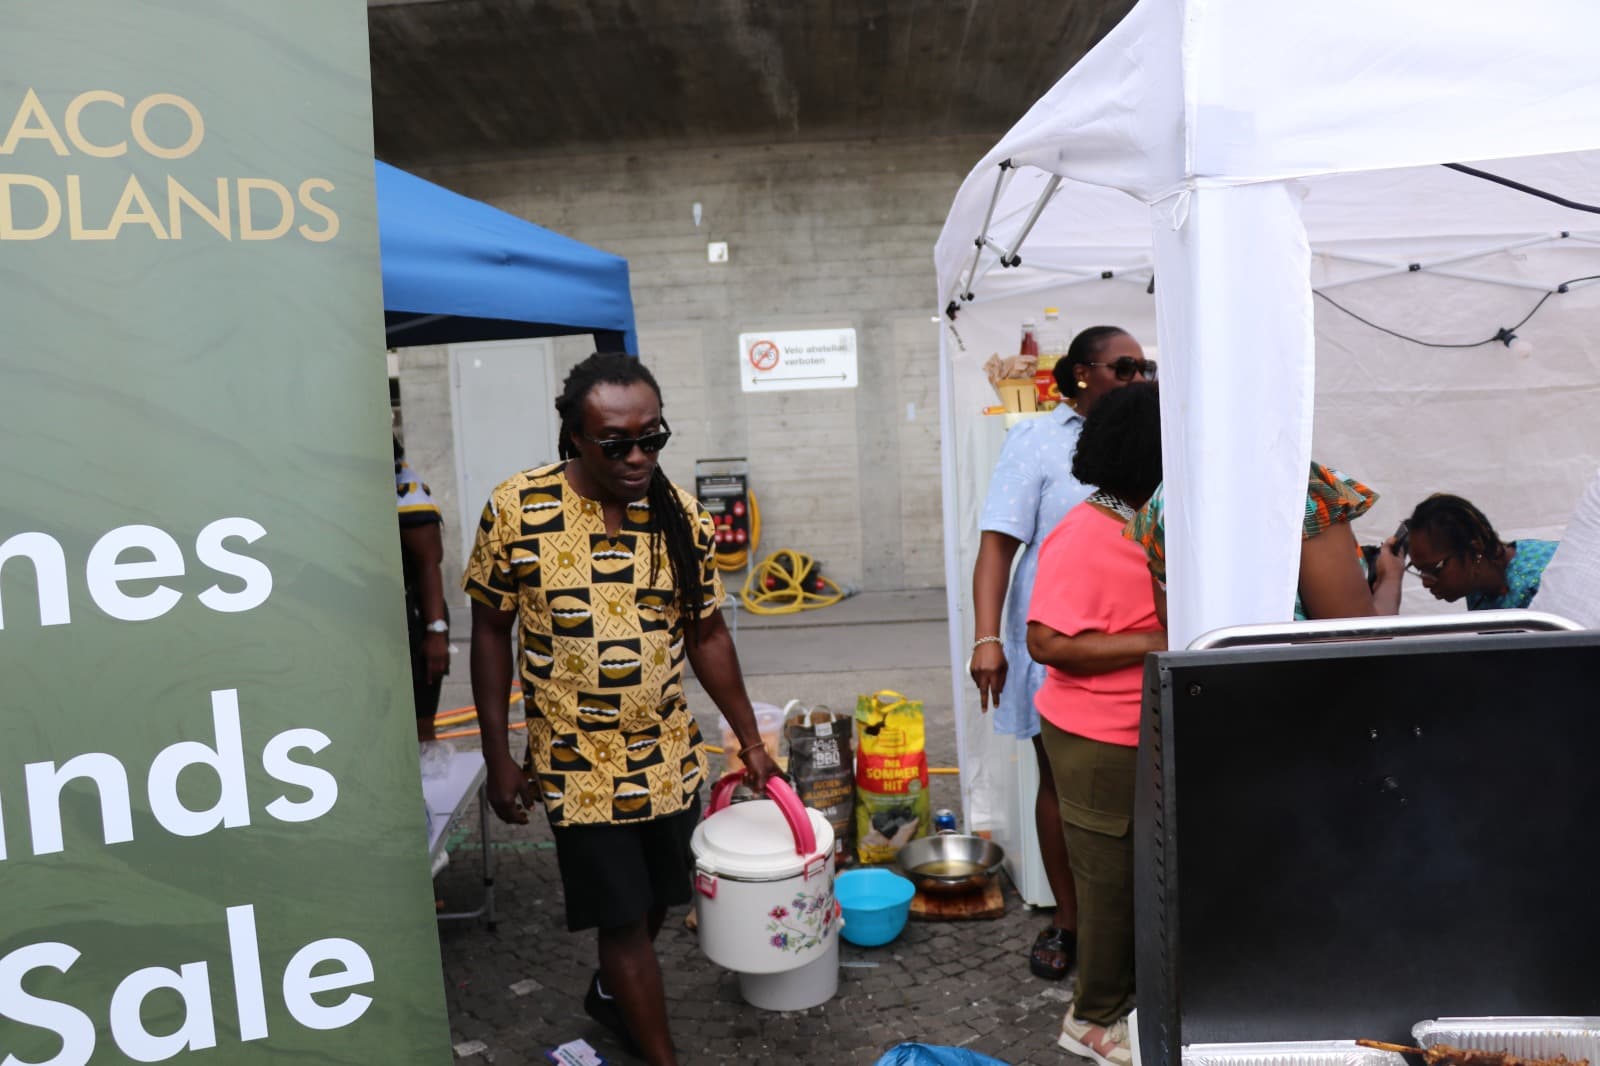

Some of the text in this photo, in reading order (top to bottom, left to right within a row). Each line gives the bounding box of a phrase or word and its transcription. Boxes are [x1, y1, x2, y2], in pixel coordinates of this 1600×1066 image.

[0, 174, 340, 243] DLANDS
[784, 345, 803, 354] Velo
[785, 357, 826, 367] verboten
[0, 689, 338, 860] nds
[867, 766, 919, 780] SOMMER
[884, 780, 904, 792] HIT
[0, 905, 375, 1066] Sale
